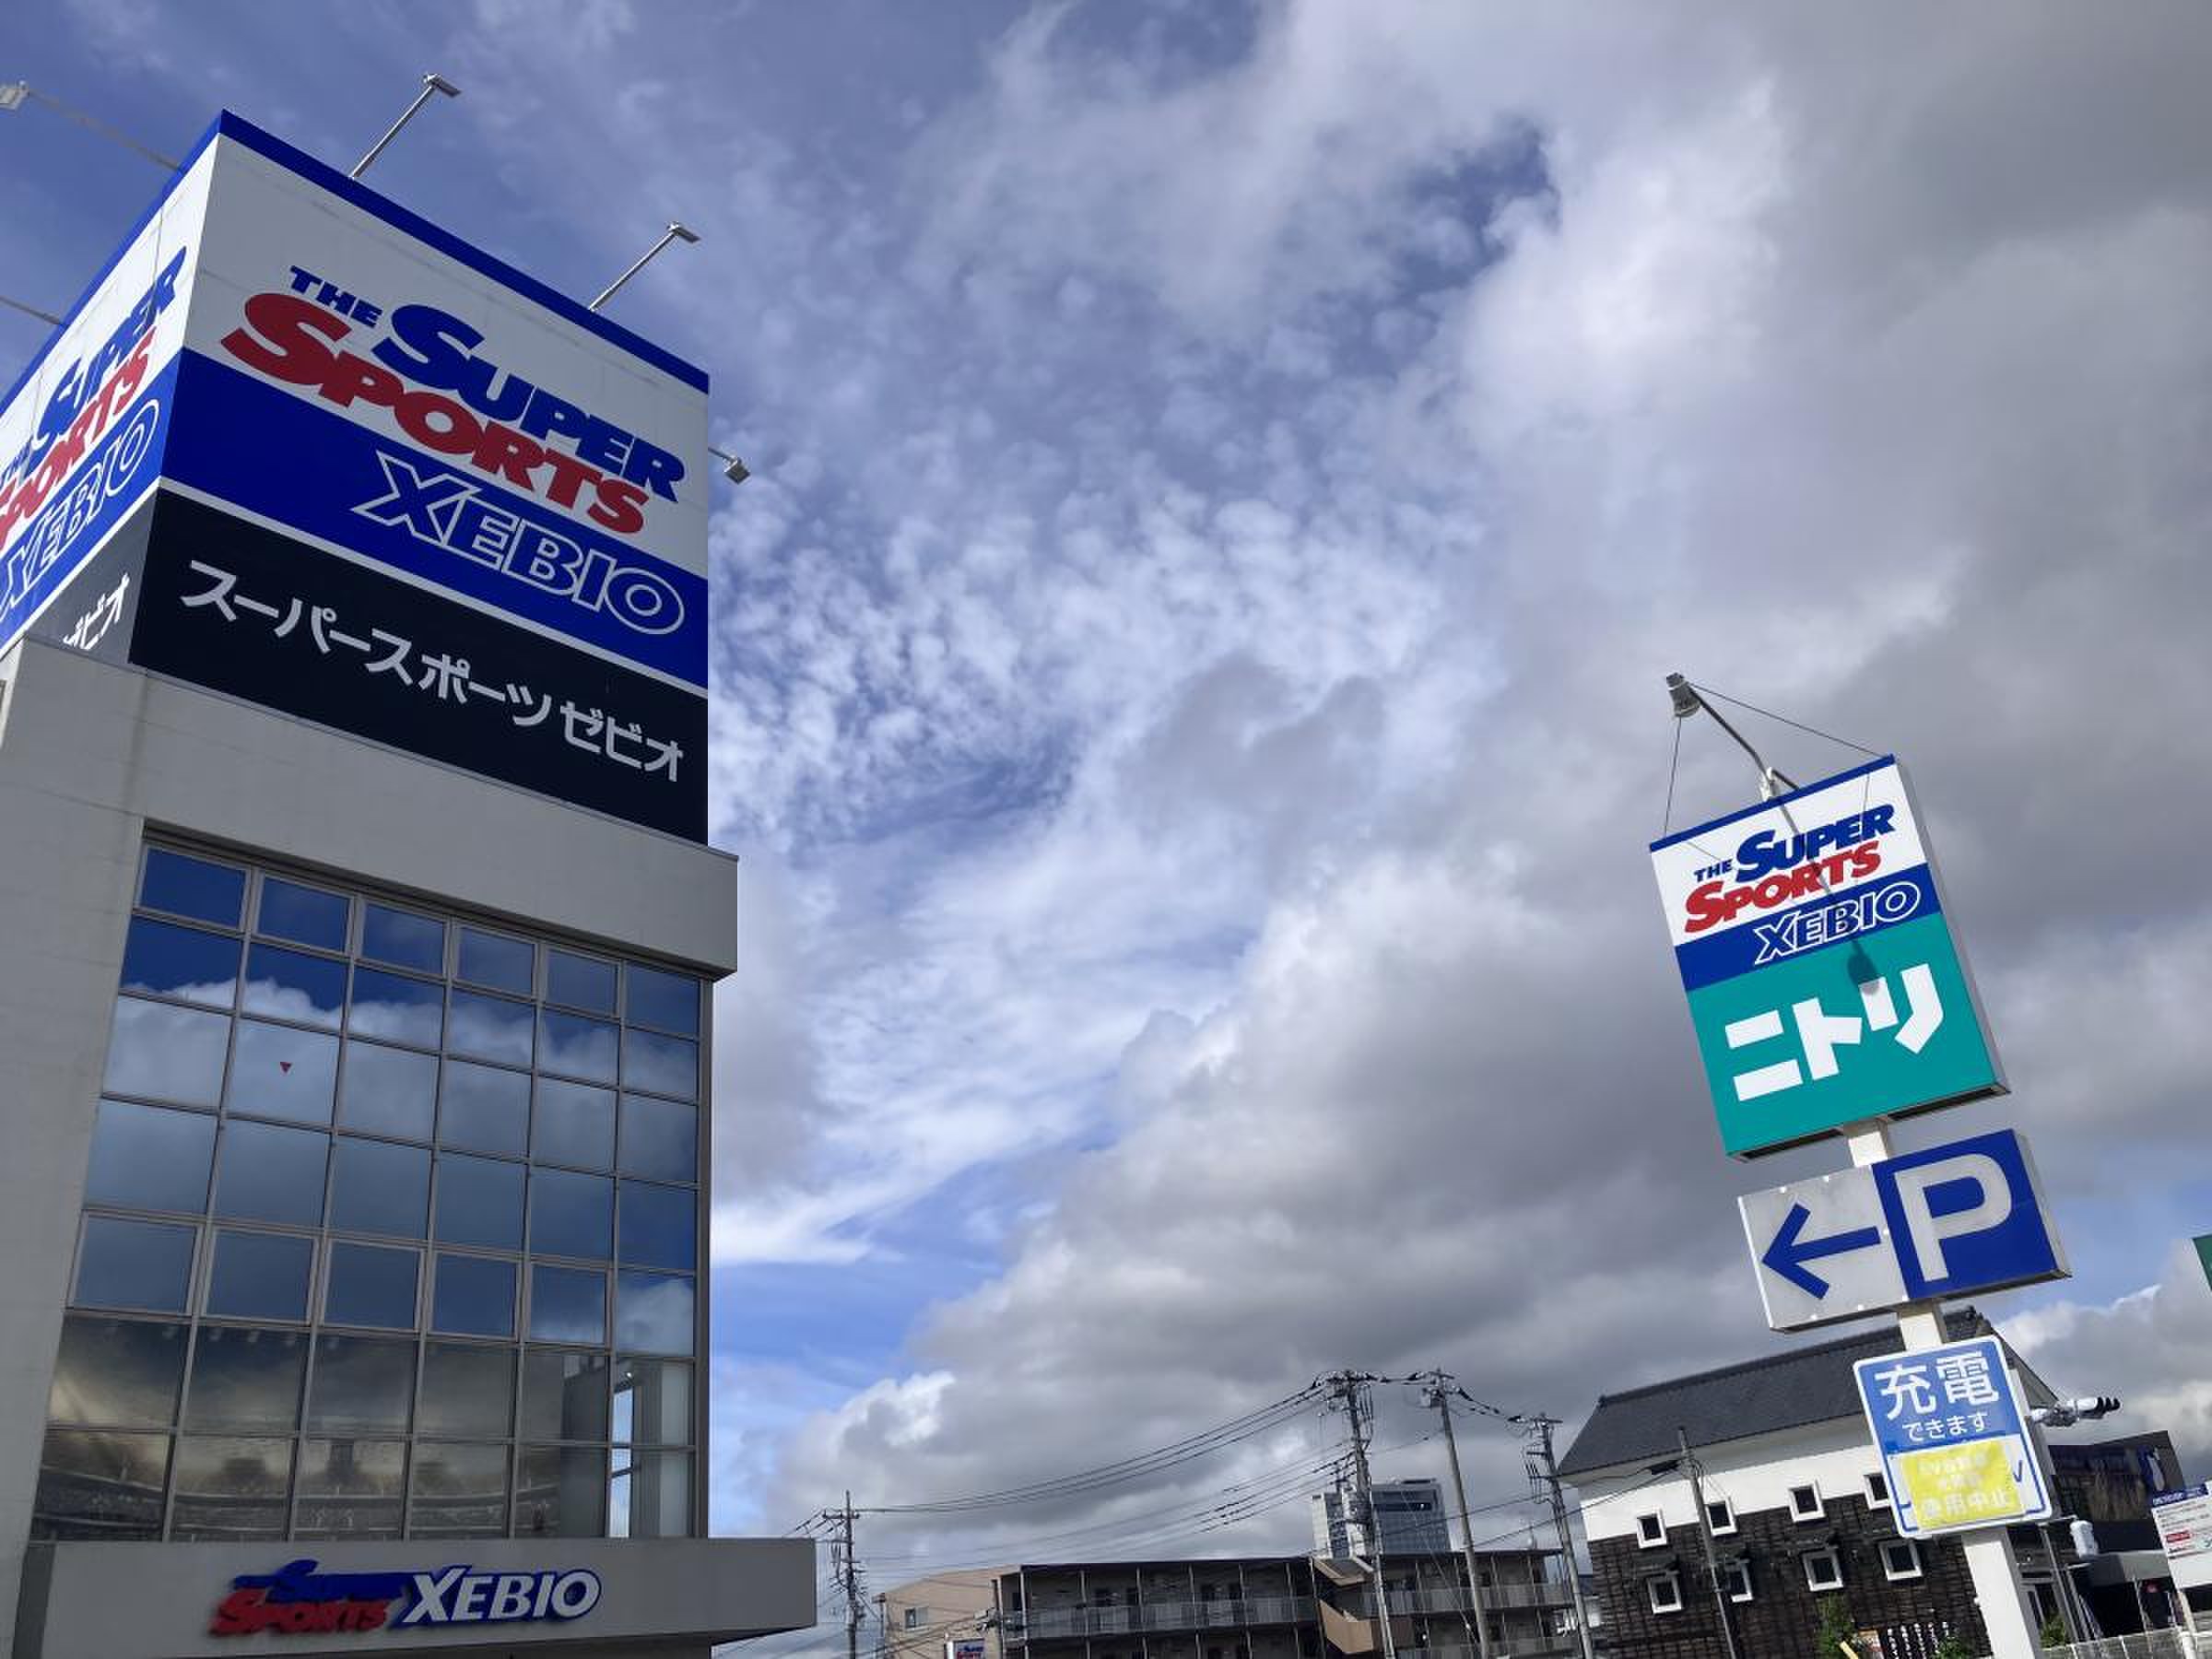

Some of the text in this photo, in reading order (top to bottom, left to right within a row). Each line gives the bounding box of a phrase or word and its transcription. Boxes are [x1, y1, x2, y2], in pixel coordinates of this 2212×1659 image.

[220, 292, 648, 534] SPORTS
[289, 265, 686, 502] THE SUPER
[353, 449, 686, 635] XEBIO
[1684, 841, 1881, 934] SPORTS
[1693, 804, 1896, 882] THE SUPER
[1753, 881, 1921, 966] XEBIO
[1724, 962, 1944, 1102] ニトリ
[1894, 1154, 2012, 1282] P
[1875, 1351, 2000, 1420] 充電
[1902, 1411, 1988, 1442] できます
[402, 1566, 601, 1624] XEBIO
